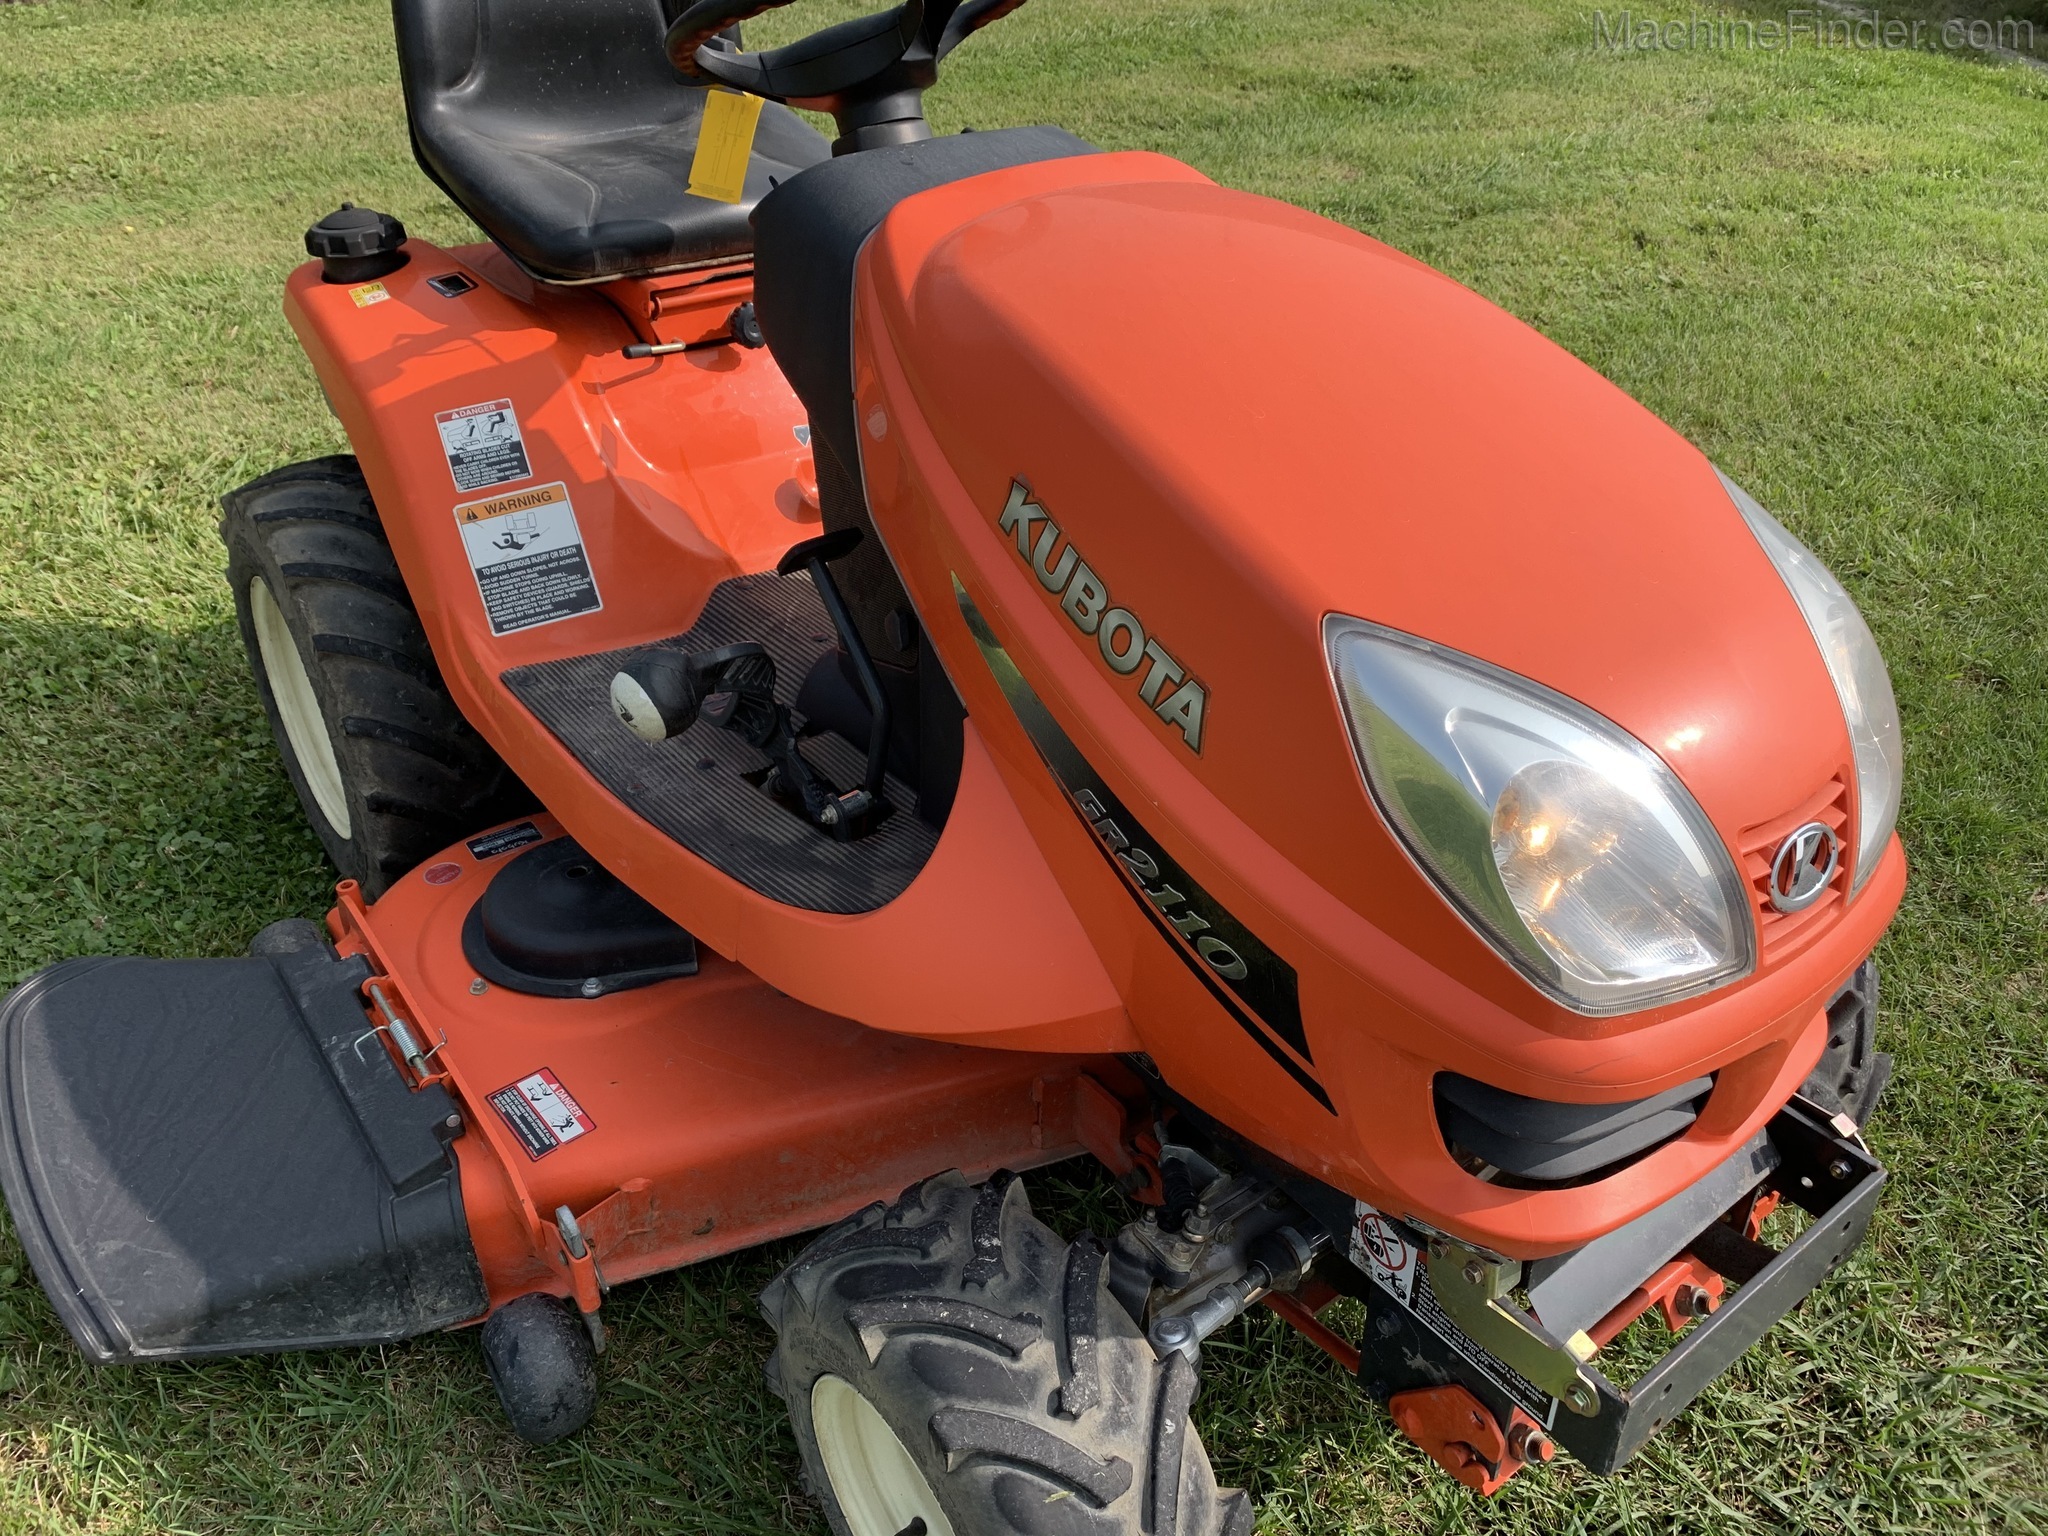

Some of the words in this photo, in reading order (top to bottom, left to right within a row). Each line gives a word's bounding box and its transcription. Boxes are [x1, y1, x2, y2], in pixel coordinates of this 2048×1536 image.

[460, 404, 496, 417] DANGER
[485, 491, 552, 515] WARNING
[482, 568, 490, 576] TO
[490, 564, 507, 574] AVOID
[507, 558, 531, 570] SERIOUS
[531, 553, 550, 564] INJURY
[550, 551, 559, 559] OR
[559, 547, 577, 557] DEATH
[491, 585, 514, 594] MACHINE
[514, 580, 531, 588] STOPS
[531, 576, 548, 584] GOING
[500, 577, 521, 586] SUDDEN
[503, 594, 523, 603] SAFETY
[523, 589, 545, 598] DEVICES
[569, 577, 590, 586] SHIELDS
[514, 602, 537, 612] OBJECTS
[551, 594, 569, 602] COULD
[494, 614, 516, 623] THROWN
[998, 480, 1206, 756] KUBOTA
[1074, 788, 1248, 980] GR2110
[555, 1089, 583, 1117] DANGER
[1422, 1275, 1430, 1286] Do
[1464, 1342, 1475, 1356] PTO
[1503, 1383, 1511, 1392] on
[1512, 1389, 1521, 1401] the
[1517, 1373, 1548, 1407] bypassed.
[1526, 1388, 1539, 1403] with
